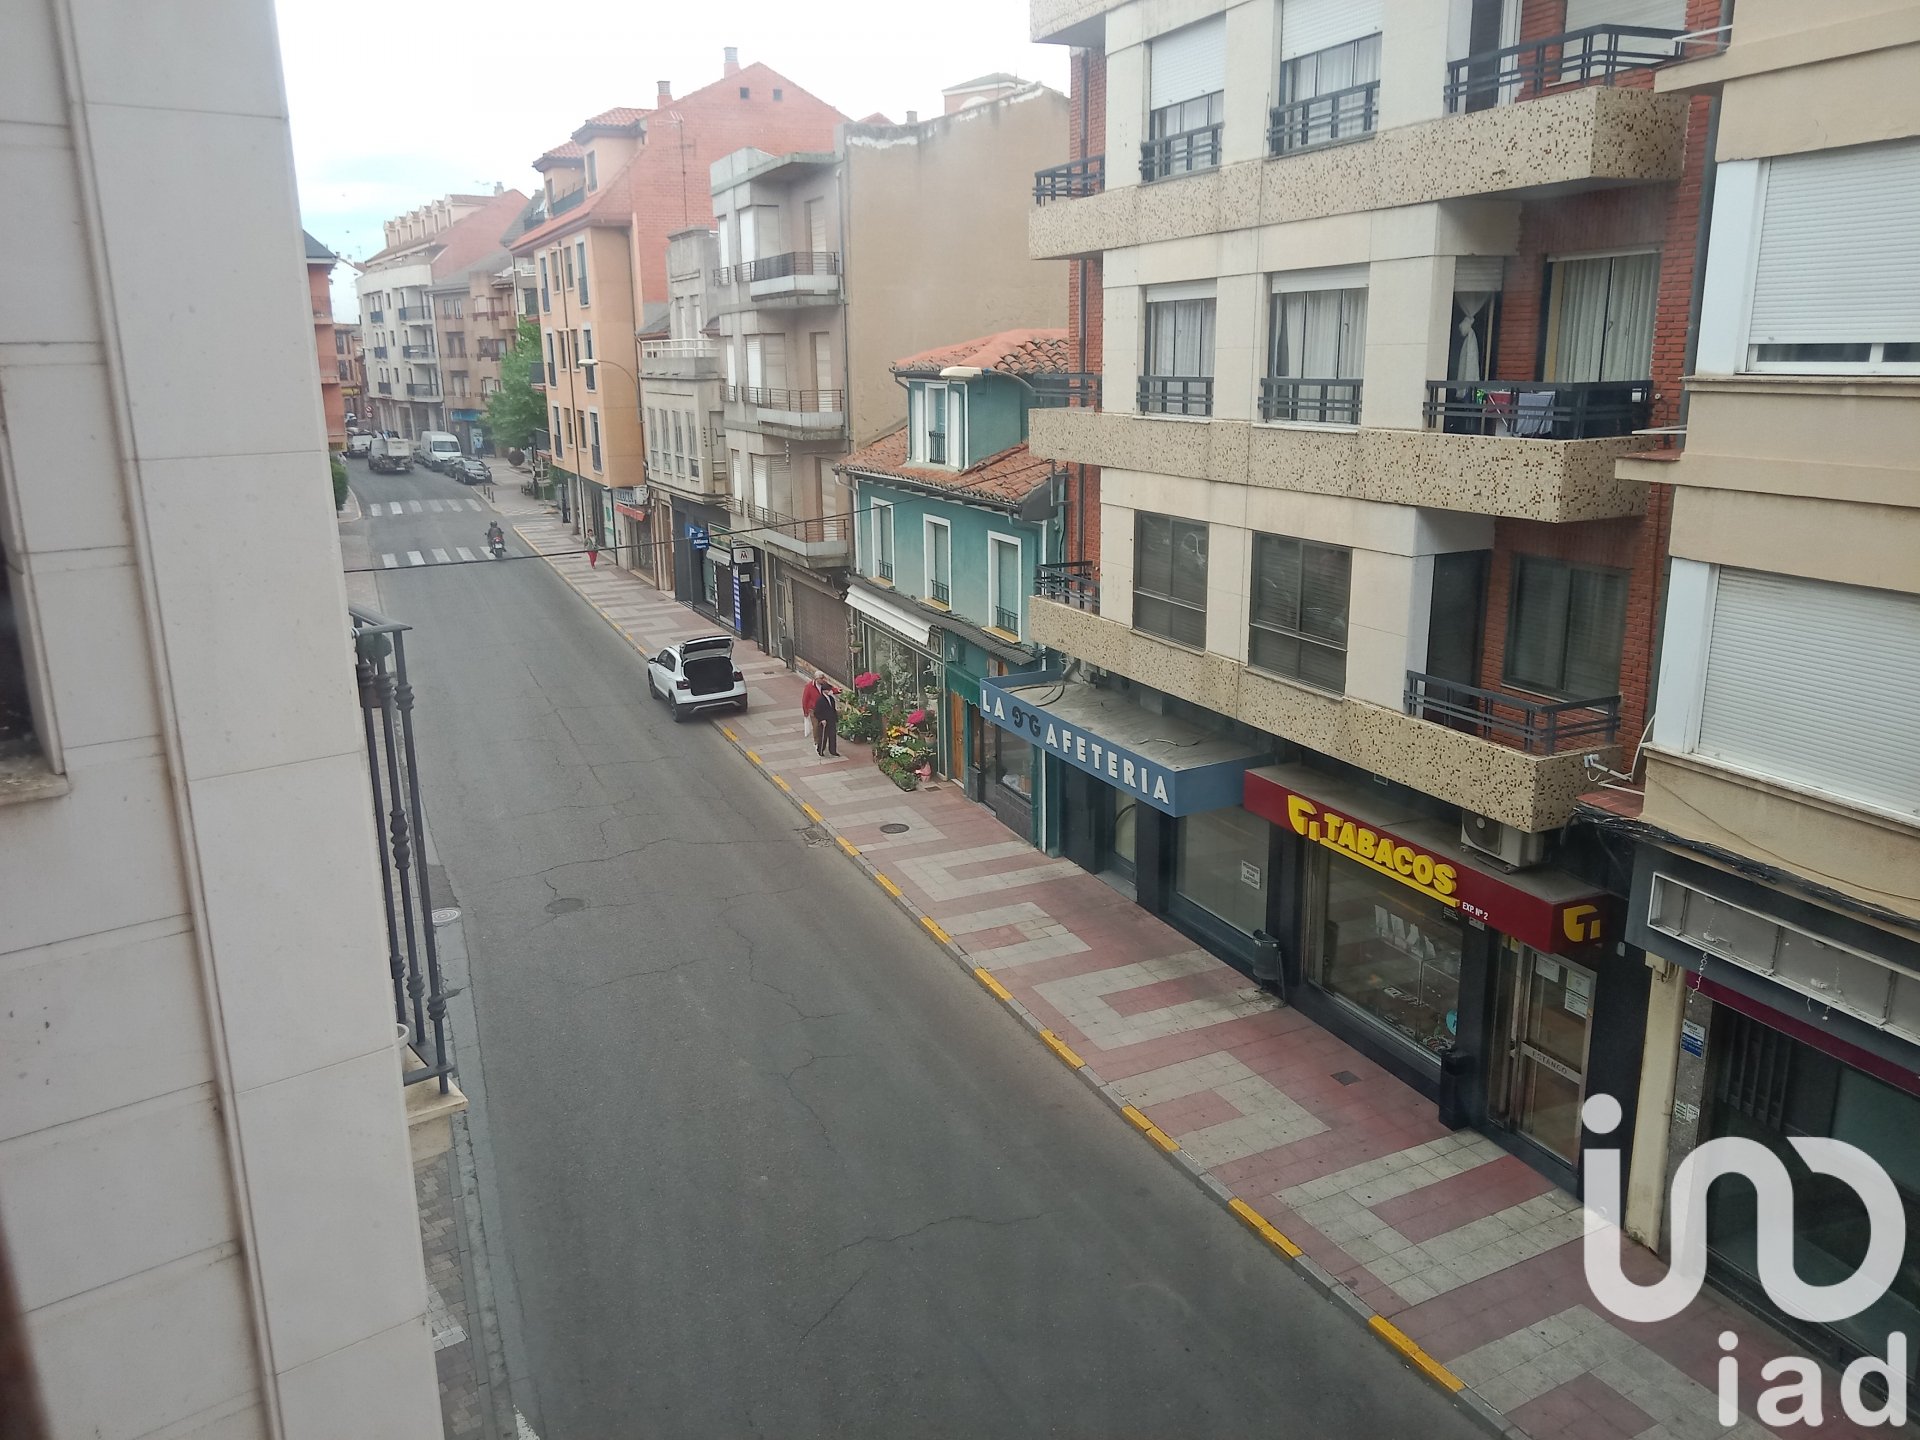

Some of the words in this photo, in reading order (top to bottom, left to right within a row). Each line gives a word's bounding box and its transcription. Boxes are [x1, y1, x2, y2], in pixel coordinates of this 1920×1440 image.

[982, 690, 1006, 721] LA
[1324, 812, 1457, 895] TABACOS
[1483, 912, 1489, 921] 2
[1532, 1049, 1568, 1075] ESTANCO
